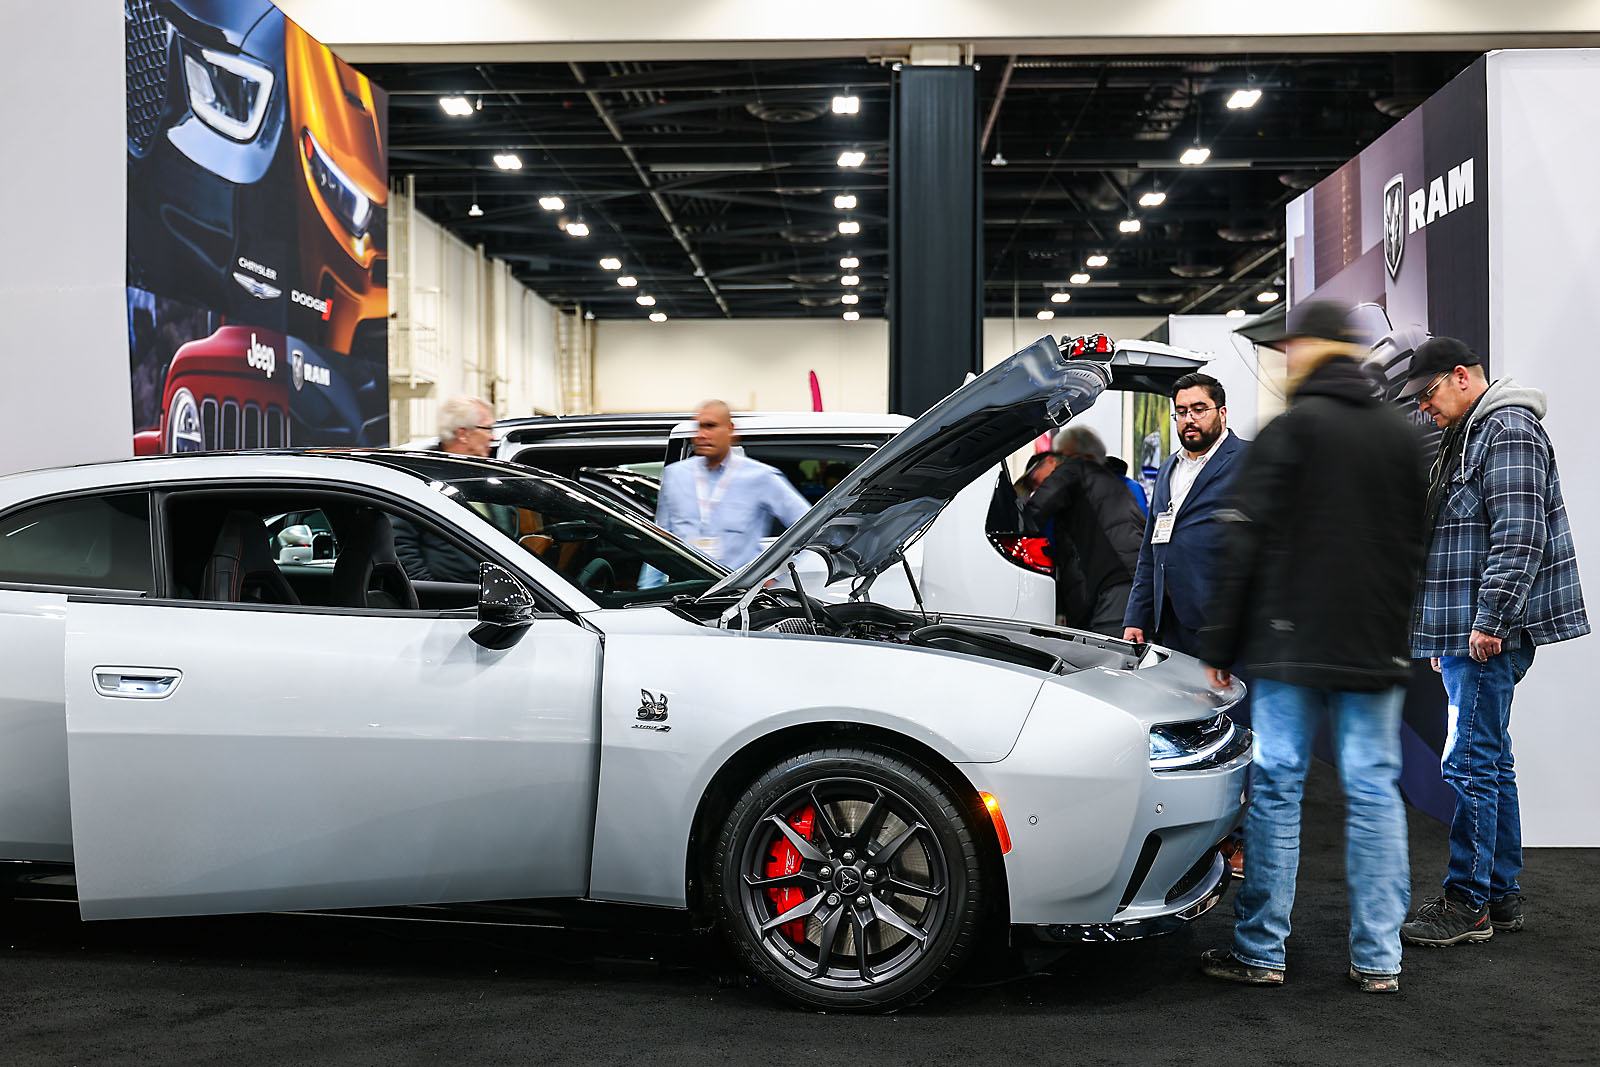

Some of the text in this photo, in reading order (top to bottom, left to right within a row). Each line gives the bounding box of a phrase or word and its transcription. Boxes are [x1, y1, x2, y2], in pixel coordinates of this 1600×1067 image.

[1408, 158, 1475, 235] RAM
[238, 257, 277, 280] CHRYSLER
[291, 289, 328, 313] DODGE
[247, 332, 275, 378] Jeep
[304, 363, 331, 386] RAM
